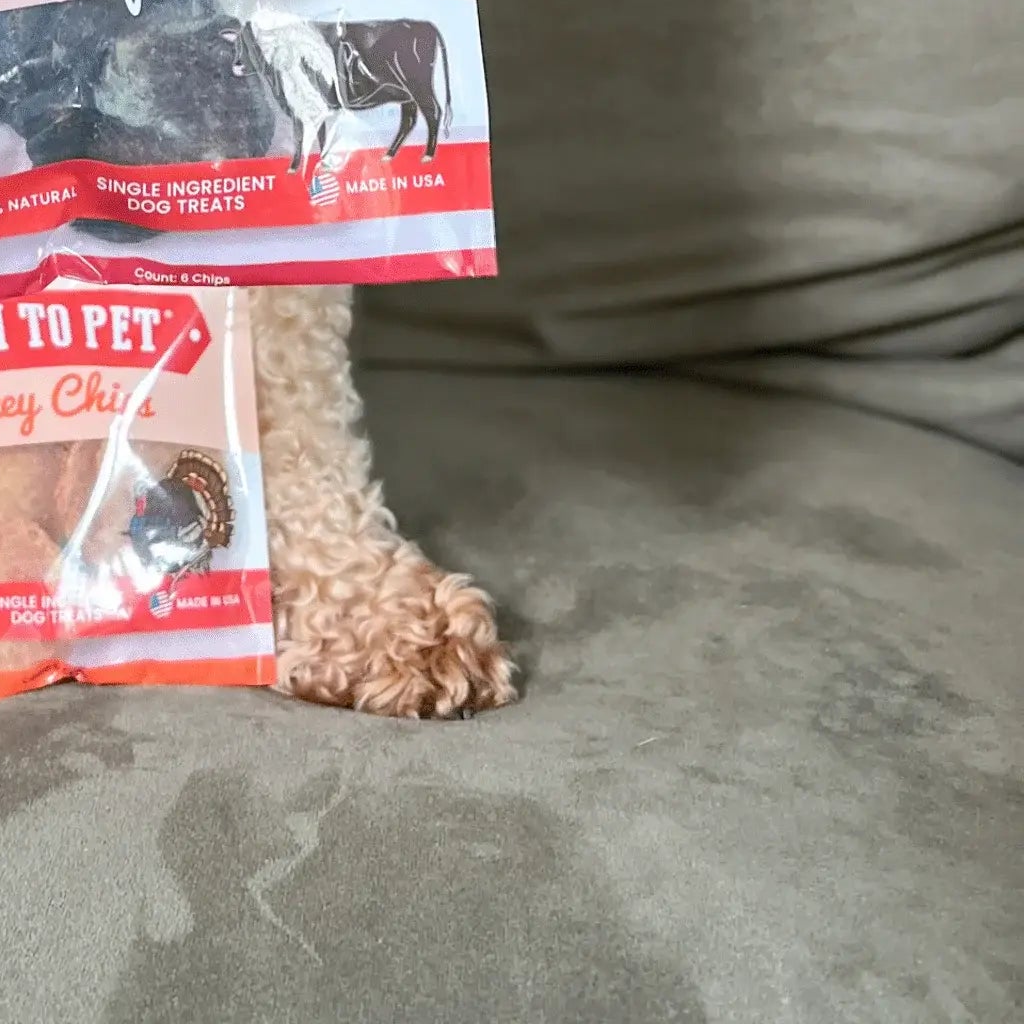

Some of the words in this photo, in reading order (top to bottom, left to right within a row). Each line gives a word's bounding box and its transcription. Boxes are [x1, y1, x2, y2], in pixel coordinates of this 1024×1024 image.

[96, 176, 162, 198] SINGLE
[166, 175, 276, 196] INGREDIENT
[345, 179, 388, 194] MADE
[391, 177, 409, 190] IN
[413, 173, 446, 188] USA
[7, 186, 78, 212] NATURAL
[127, 197, 171, 215] DOG
[177, 195, 246, 214] TREATS
[180, 273, 189, 283] 6
[192, 273, 231, 286] Chips
[17, 302, 73, 349] TO
[51, 370, 157, 418] Chis
[10, 610, 46, 625] DOG
